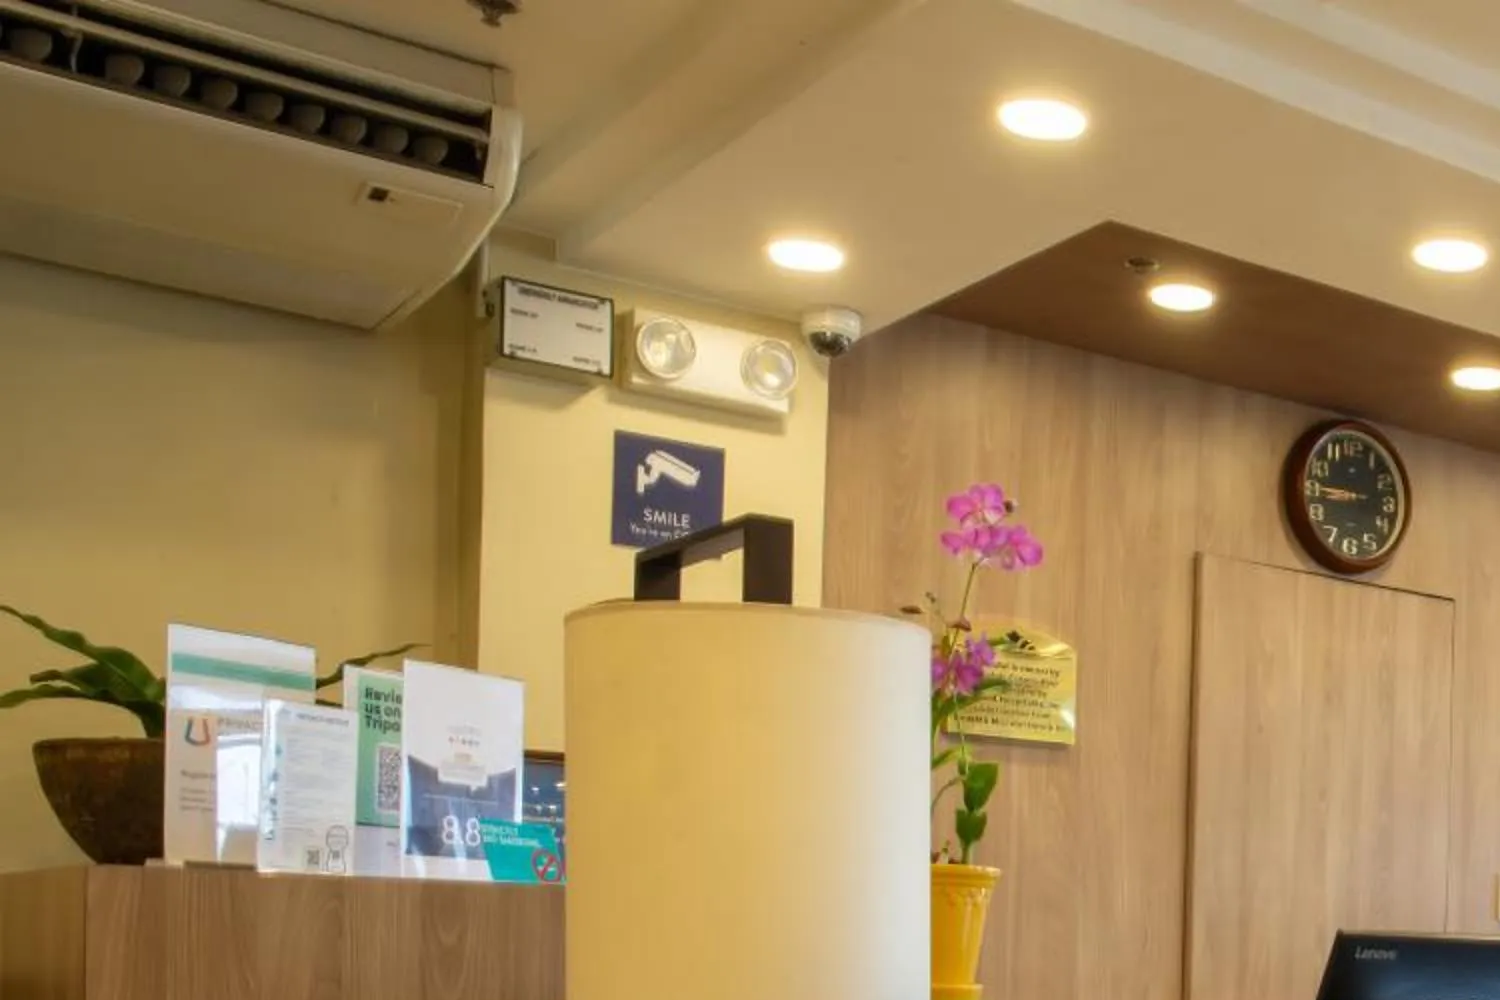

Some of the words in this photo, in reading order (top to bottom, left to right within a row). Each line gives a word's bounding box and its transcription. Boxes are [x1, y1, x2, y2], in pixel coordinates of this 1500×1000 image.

[1328, 443, 1340, 461] 11
[1312, 458, 1328, 477] 10
[1369, 453, 1375, 469] 1
[1305, 480, 1320, 496] 9
[1377, 474, 1392, 490] 2
[1310, 504, 1324, 520] 8
[1383, 496, 1395, 512] 3
[643, 507, 691, 529] SMILE
[1376, 516, 1389, 533] 4
[1323, 525, 1338, 542] 7
[1363, 533, 1377, 550] 5
[1342, 538, 1358, 554] 6
